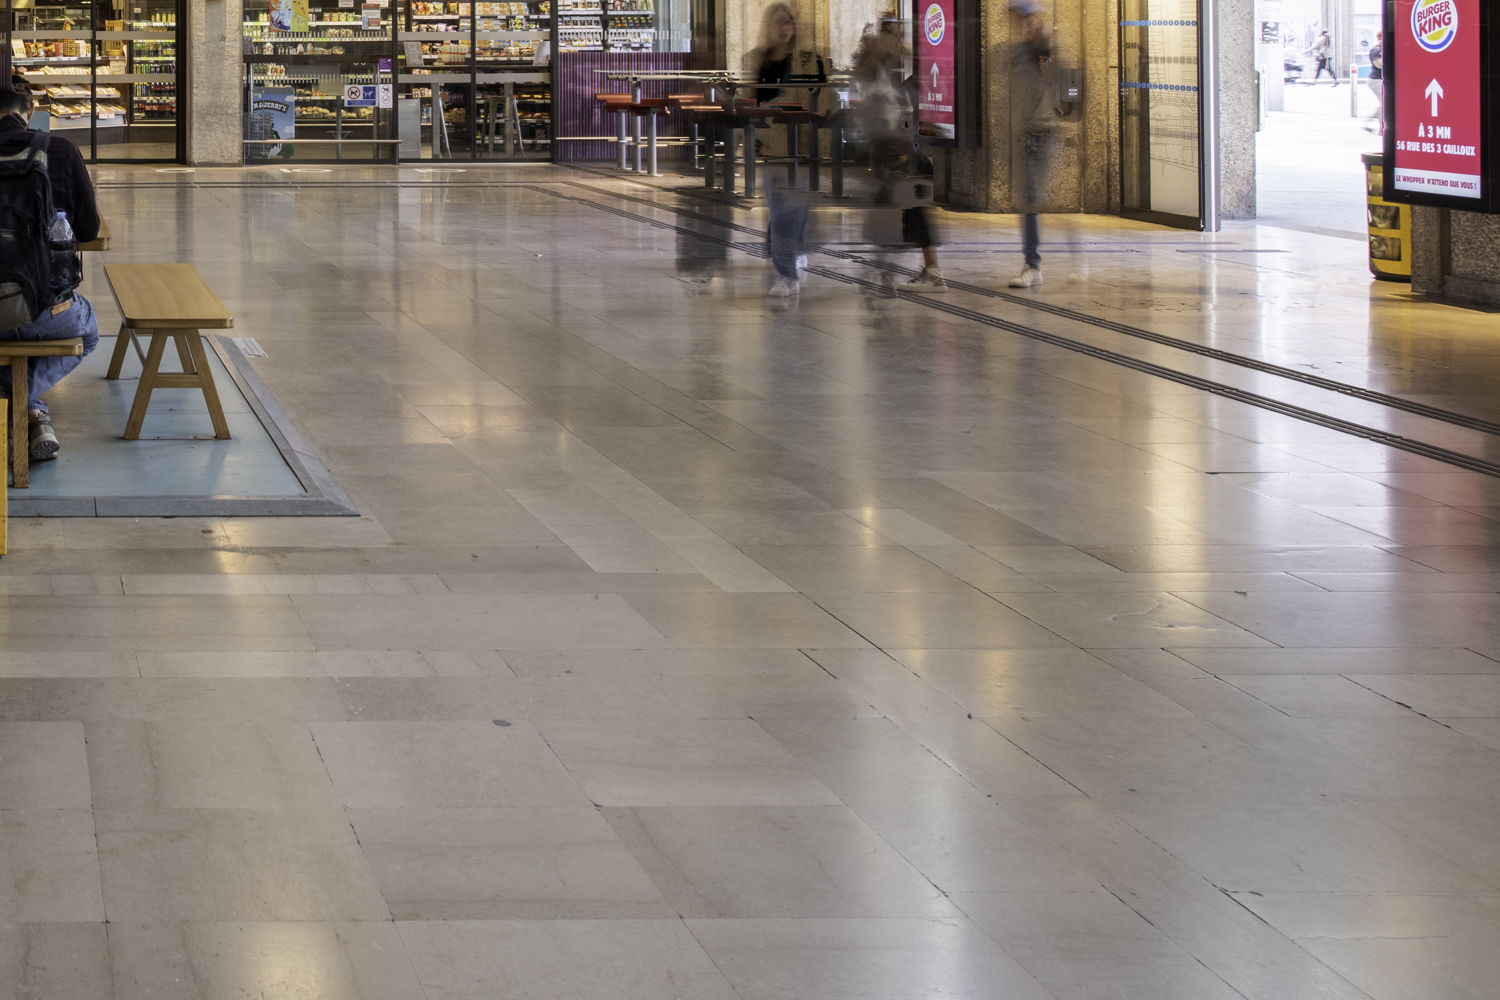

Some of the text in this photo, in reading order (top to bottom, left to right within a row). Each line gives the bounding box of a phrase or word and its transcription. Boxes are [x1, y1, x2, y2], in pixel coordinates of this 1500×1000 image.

[928, 11, 942, 26] BURGER
[1417, 1, 1450, 23] BURGER
[928, 18, 942, 35] KING
[1419, 11, 1451, 38] KING
[263, 102, 287, 112] JERRY'S
[1418, 122, 1451, 139] À 3 MN
[1396, 140, 1476, 156] 56 RUE DES 3 CAILLOUX
[1402, 175, 1425, 184] WHOPPER
[1427, 178, 1449, 187] N'ATTEND
[1450, 180, 1459, 188] QUE
[1460, 182, 1473, 190] VOUS
